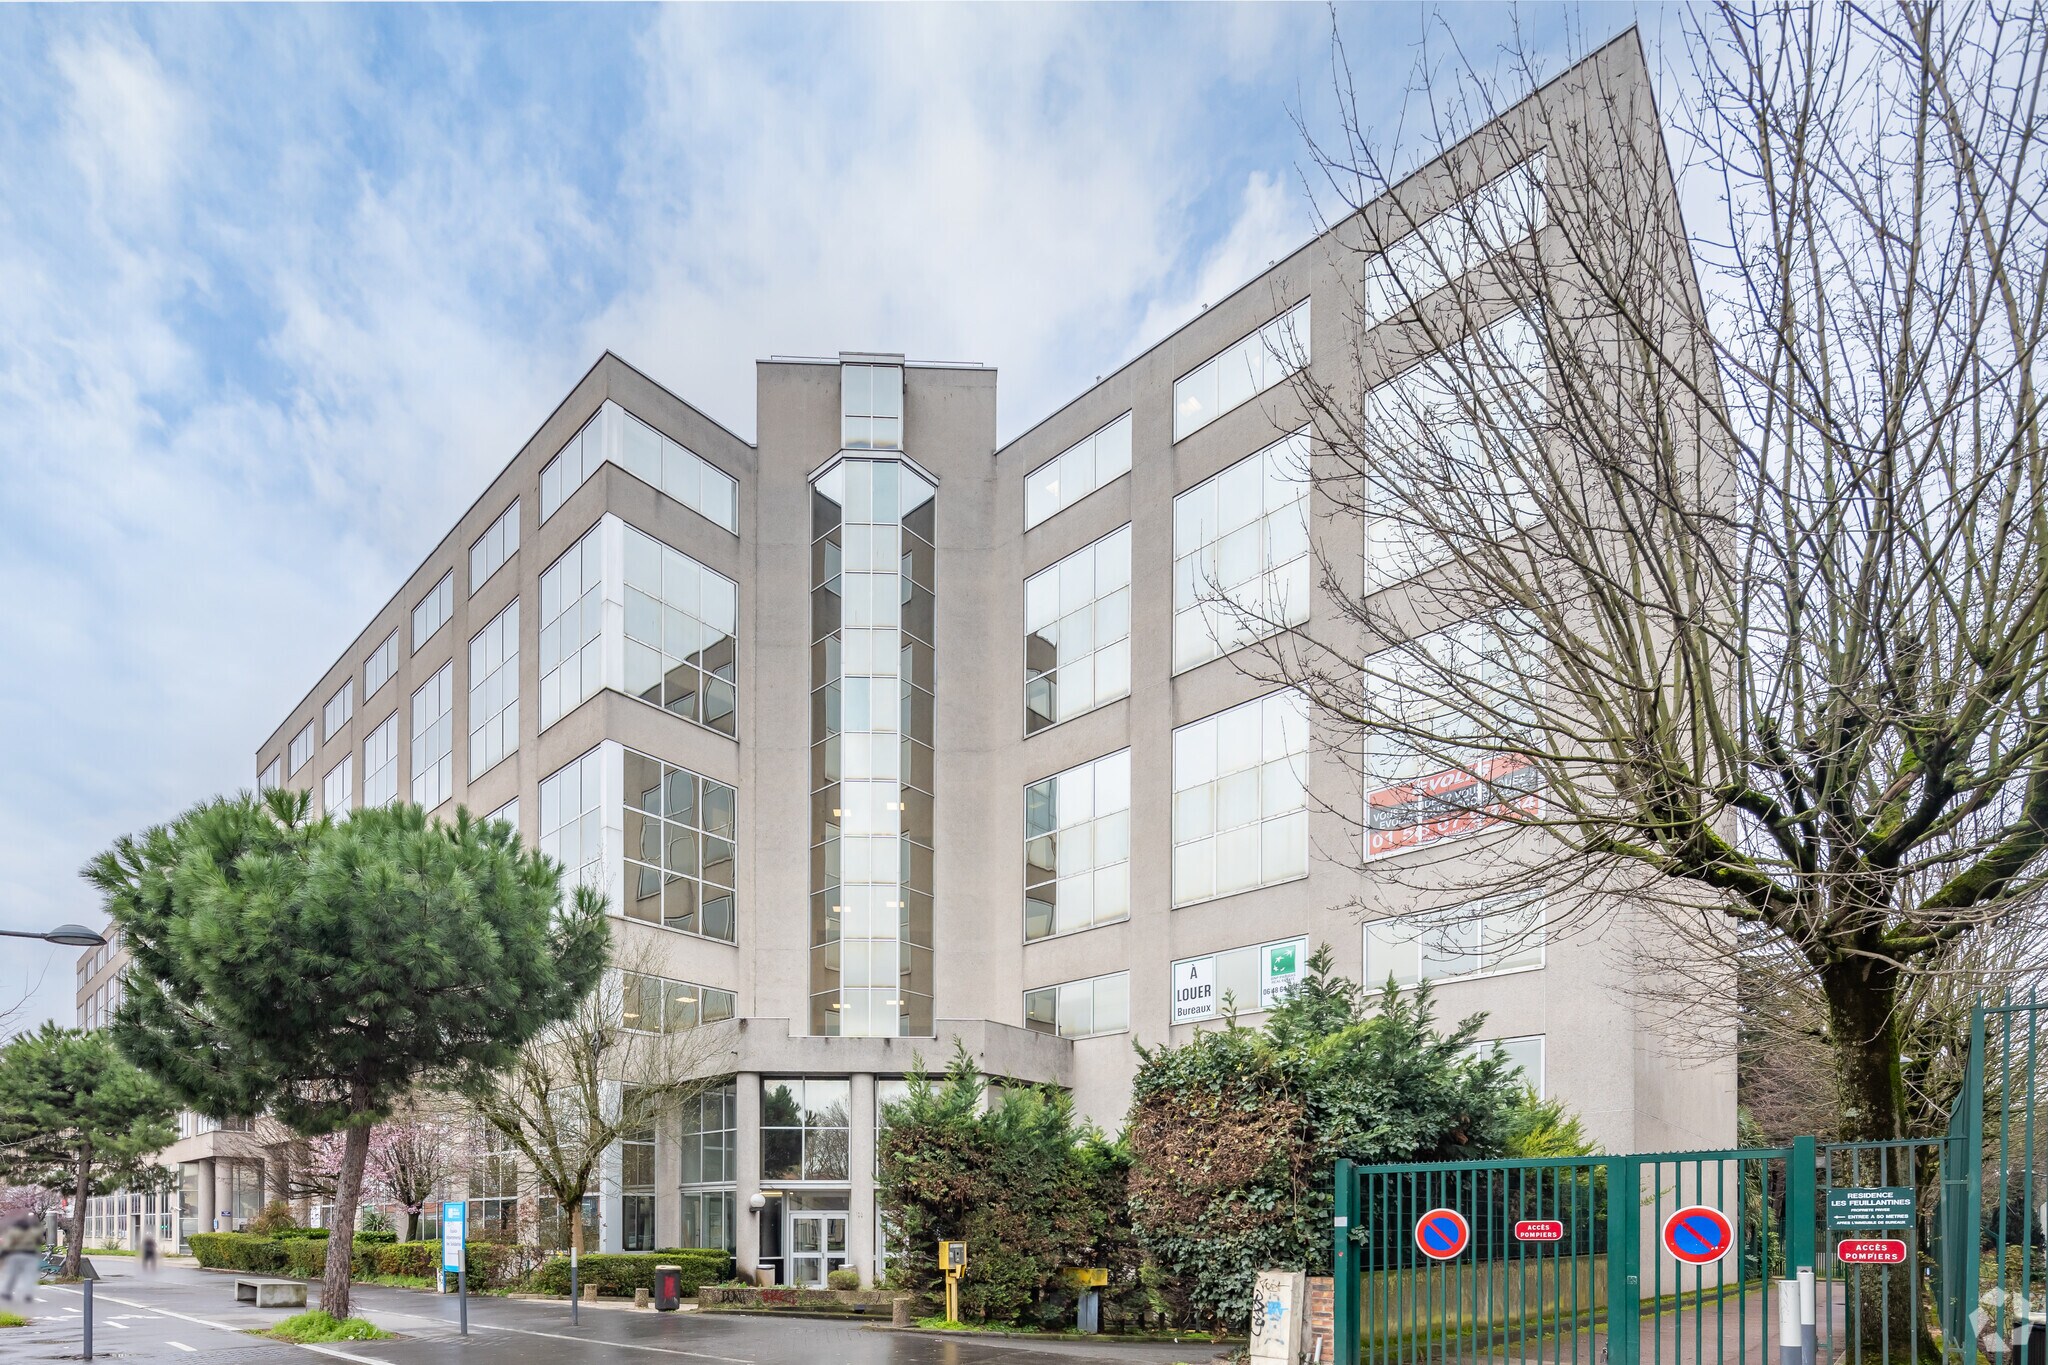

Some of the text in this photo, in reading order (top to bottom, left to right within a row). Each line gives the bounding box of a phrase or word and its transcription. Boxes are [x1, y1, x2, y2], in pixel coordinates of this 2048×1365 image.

[1372, 831, 1394, 849] 01
[1190, 964, 1198, 980] À
[1177, 984, 1212, 1002] LOUER
[1177, 1004, 1211, 1017] Bureaux
[1855, 1243, 1888, 1251] ACCÈS
